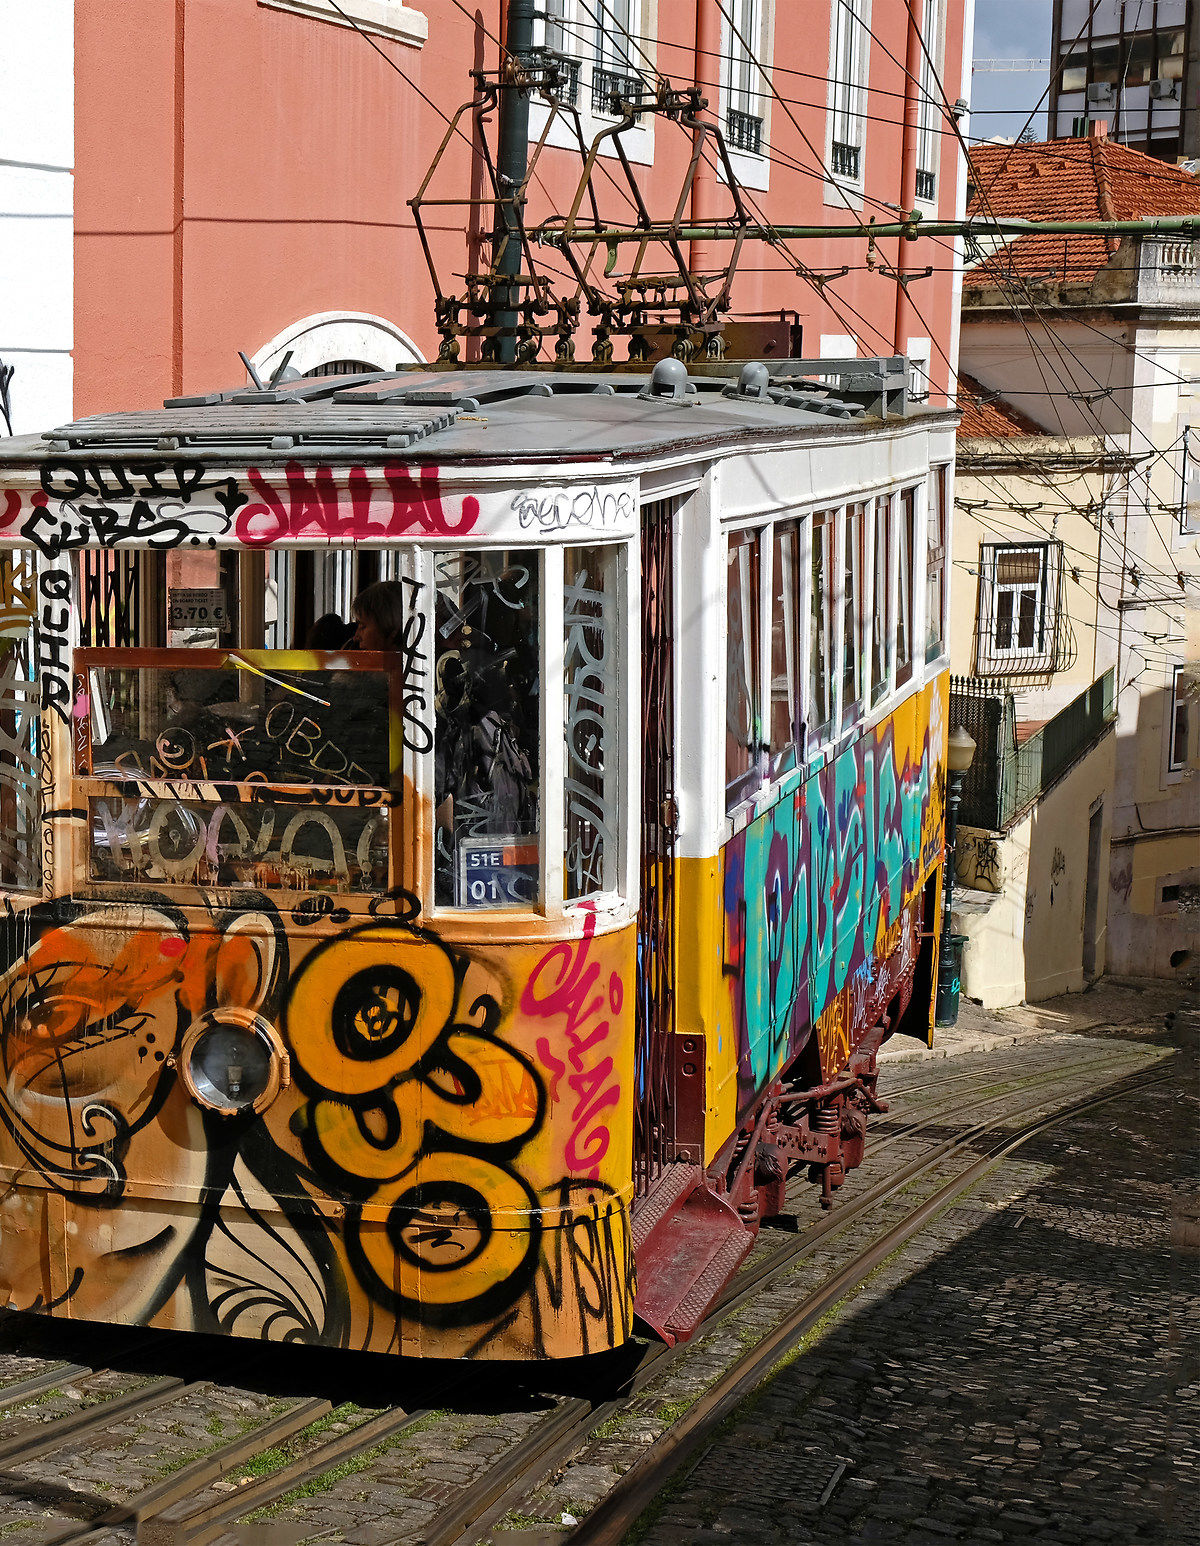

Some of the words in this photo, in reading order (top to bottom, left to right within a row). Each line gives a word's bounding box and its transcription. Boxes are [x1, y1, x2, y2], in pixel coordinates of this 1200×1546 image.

[173, 606, 208, 620] 3.70
[213, 606, 223, 620] €
[470, 852, 500, 867] 51E
[471, 878, 498, 900] 01
